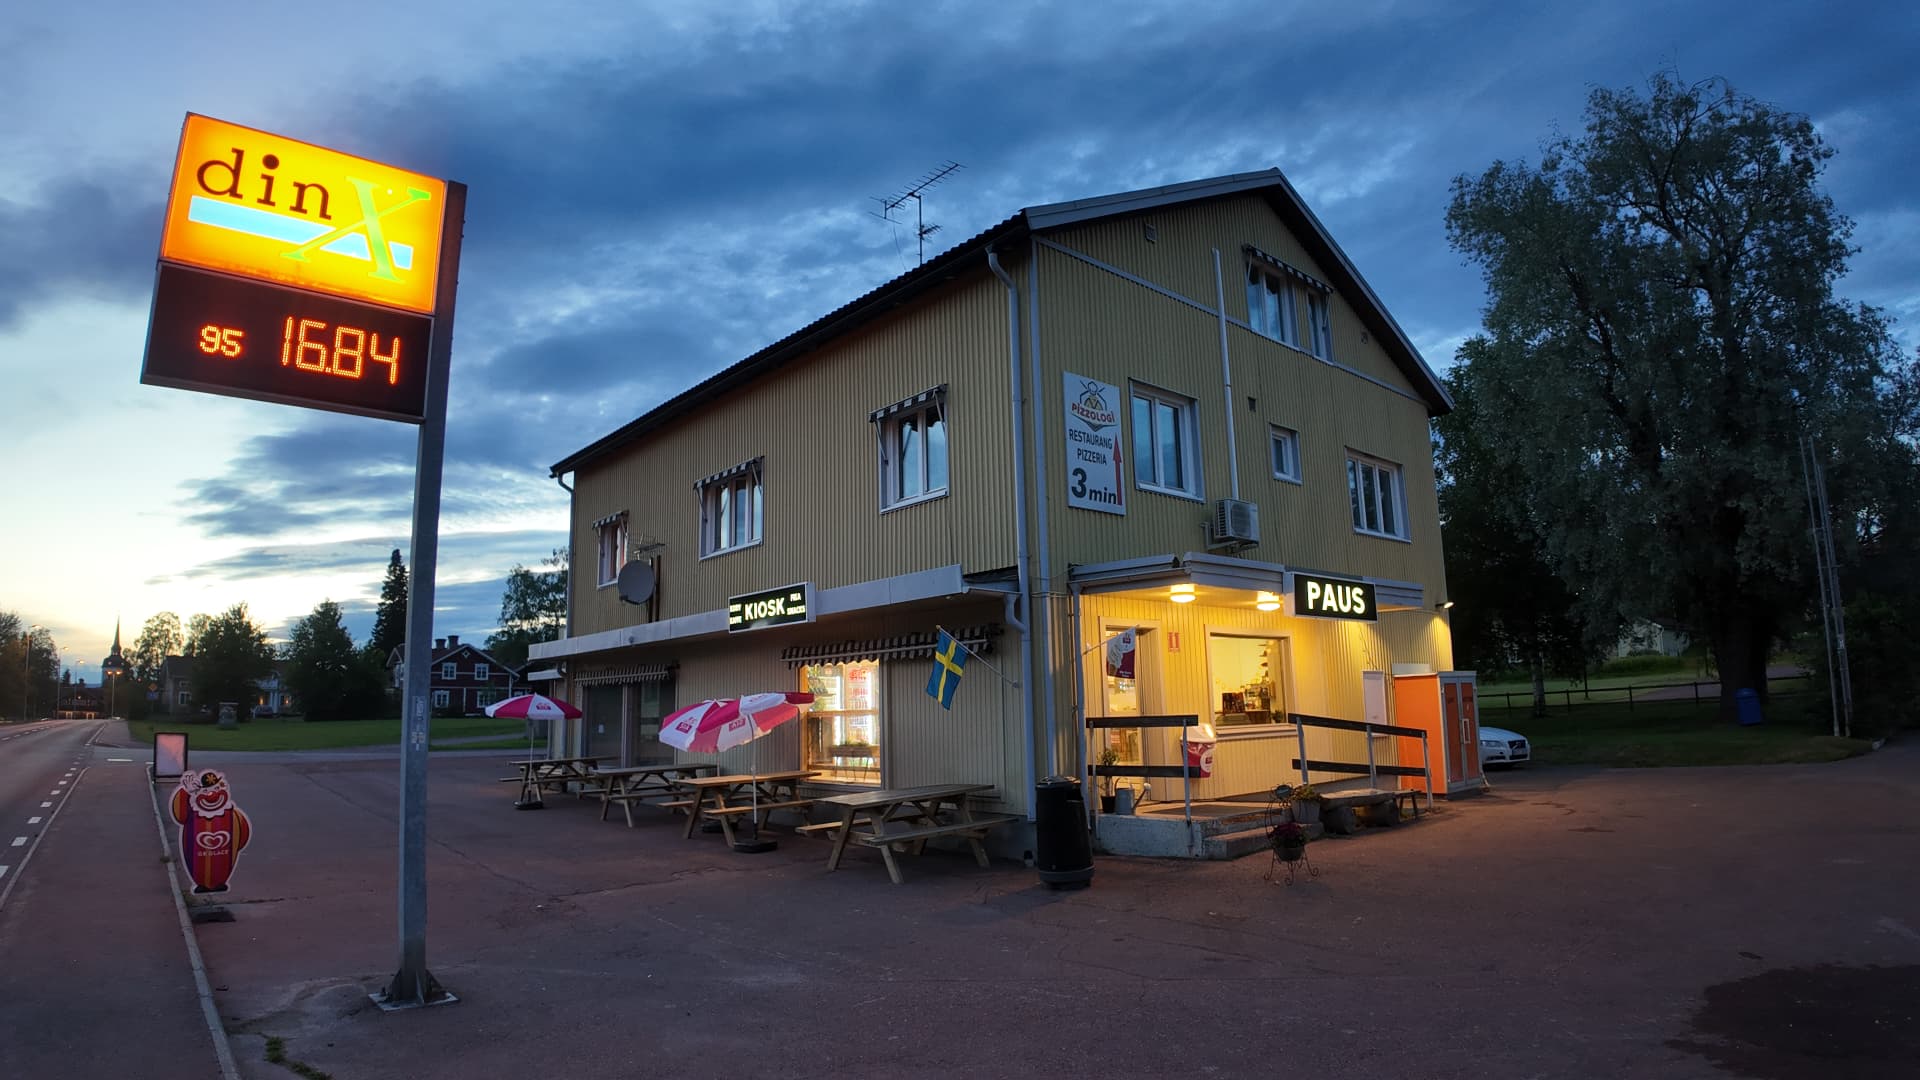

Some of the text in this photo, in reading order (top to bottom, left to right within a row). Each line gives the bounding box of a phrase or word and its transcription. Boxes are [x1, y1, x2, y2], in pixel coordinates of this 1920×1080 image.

[200, 316, 400, 384] 95 16.84
[1069, 428, 1113, 450] RESTAURANG
[1077, 448, 1107, 465] PIZZERIA
[1071, 467, 1117, 505] 3 min
[745, 598, 785, 620] KIOSK
[1307, 581, 1366, 615] PAUS
